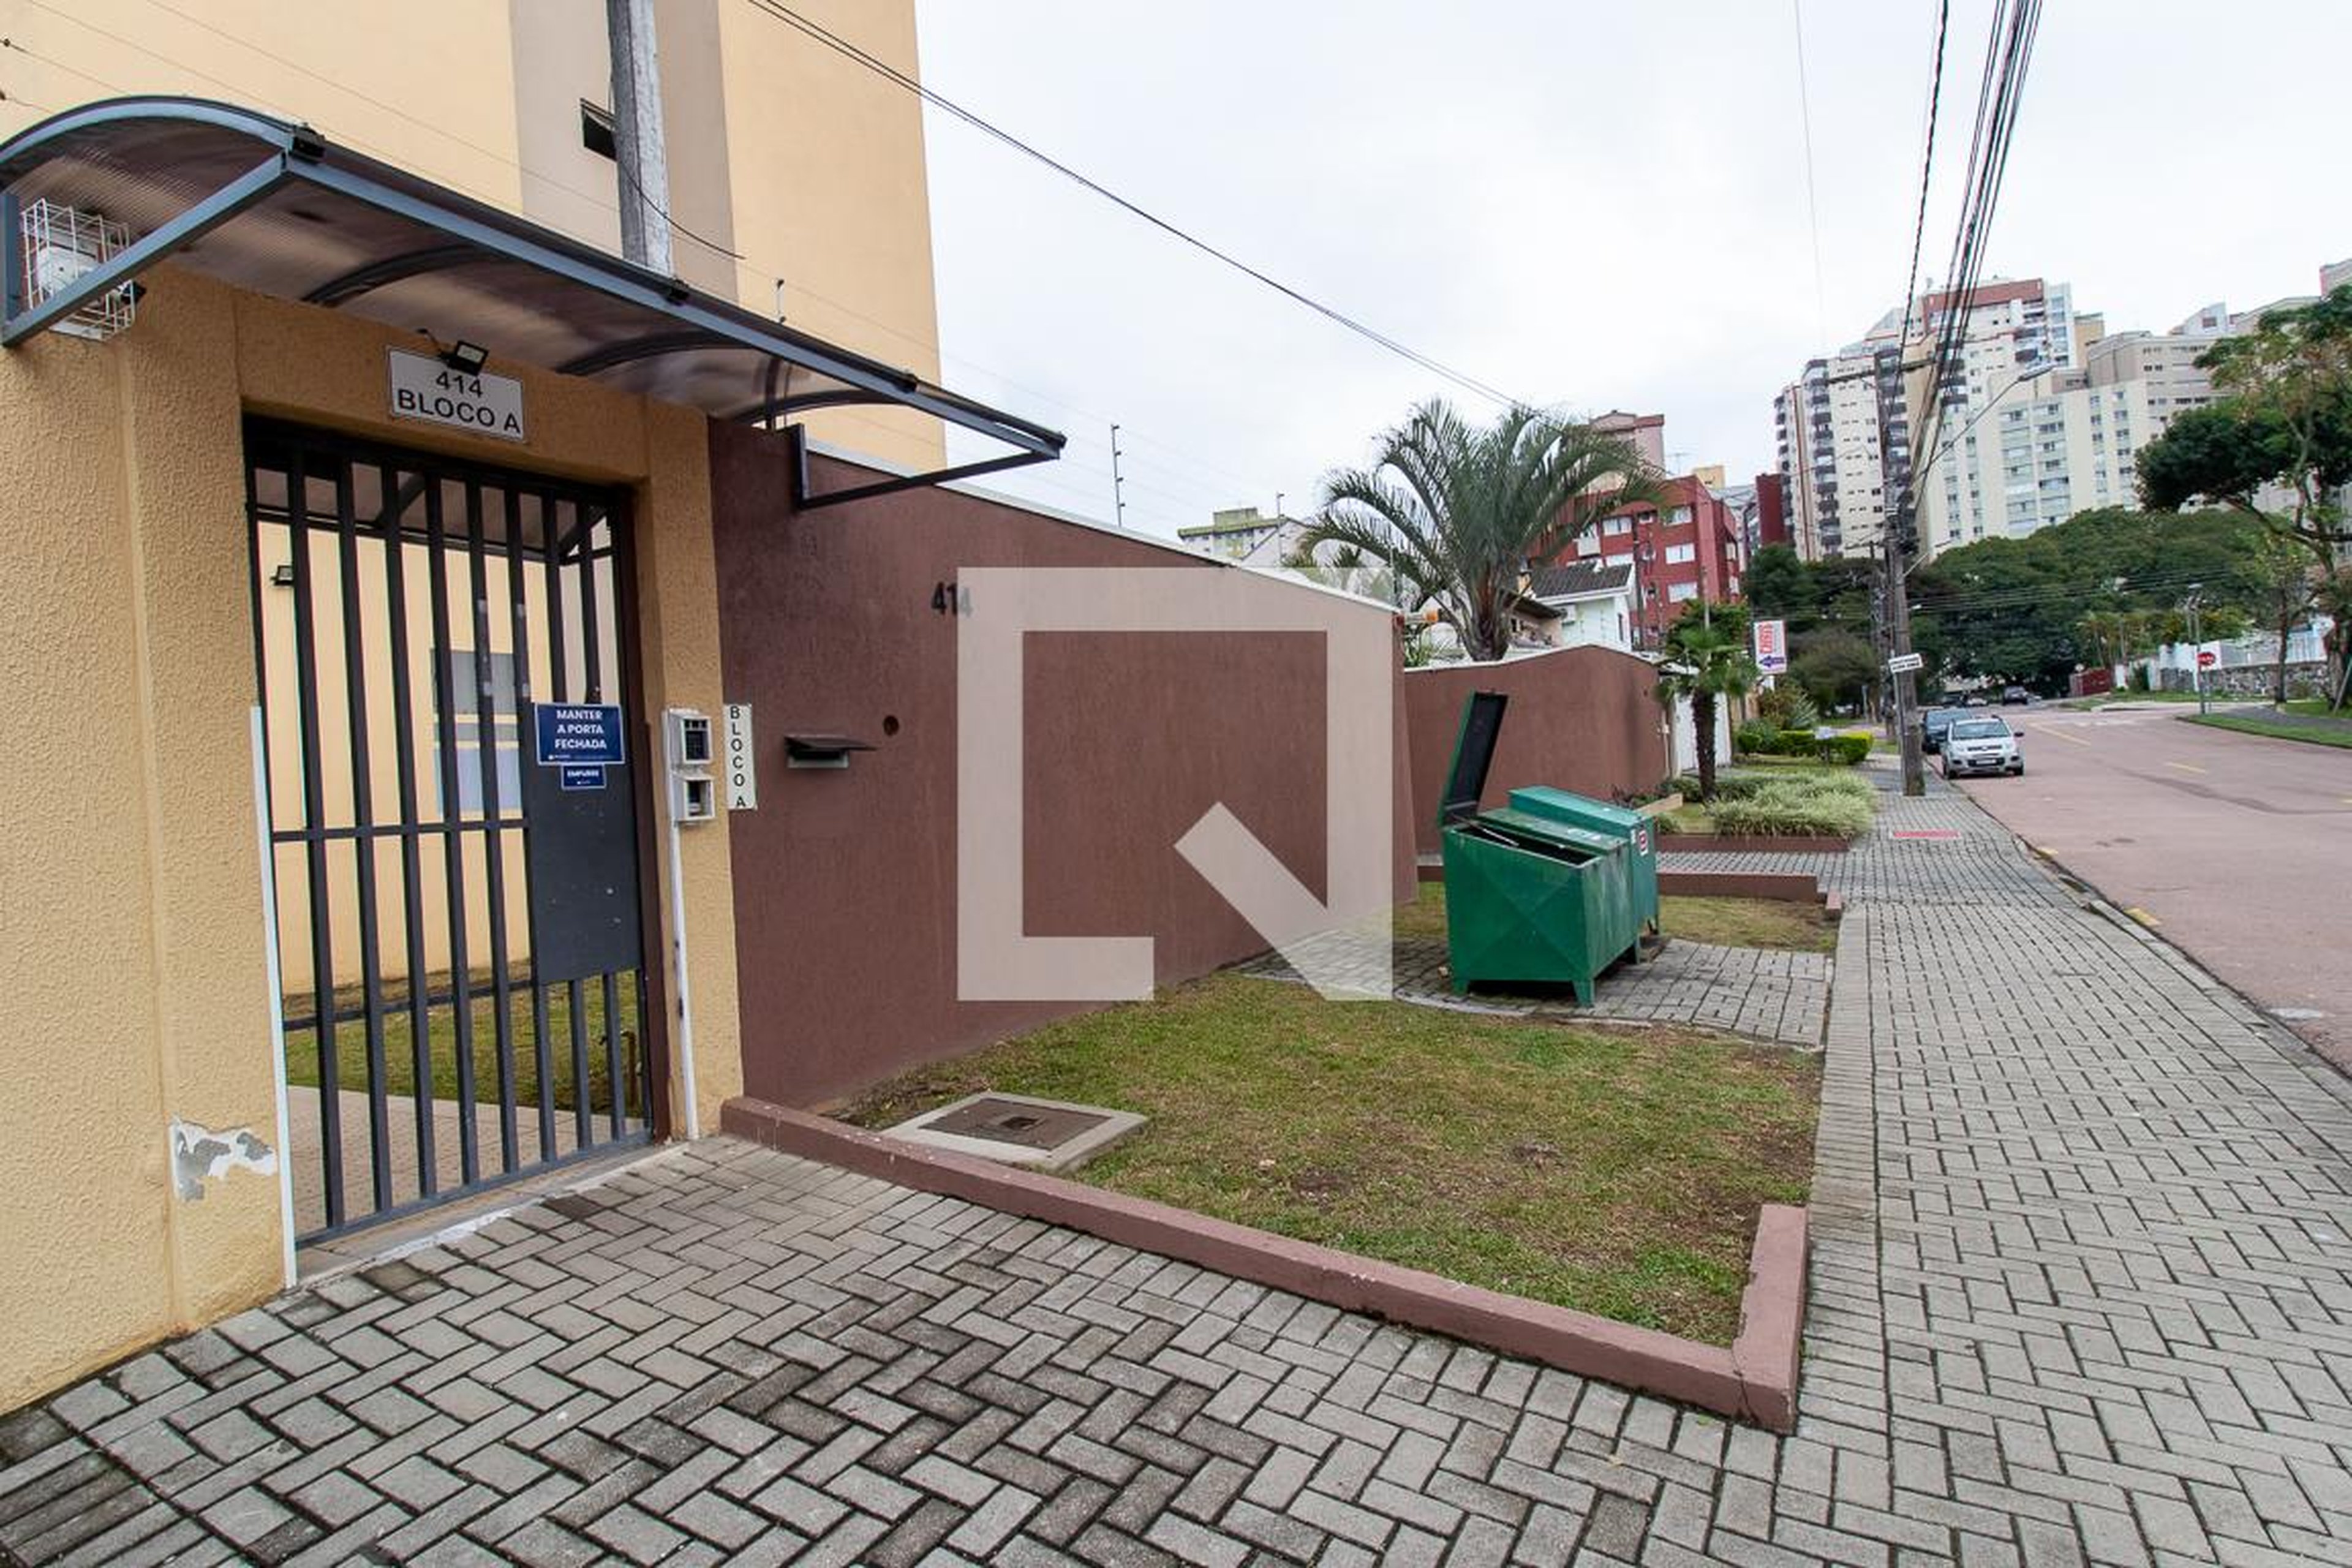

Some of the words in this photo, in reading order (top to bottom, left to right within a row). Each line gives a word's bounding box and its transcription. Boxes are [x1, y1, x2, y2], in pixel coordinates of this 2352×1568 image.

[435, 371, 483, 398] 414
[398, 389, 496, 427] BLOCO
[503, 412, 521, 433] A
[931, 581, 974, 618] 414
[556, 710, 603, 720] MANTER
[557, 725, 566, 734] A
[567, 724, 604, 734] PORTA
[554, 739, 608, 749] FECHADA
[729, 706, 745, 787] BLOCO
[736, 796, 746, 807] A
